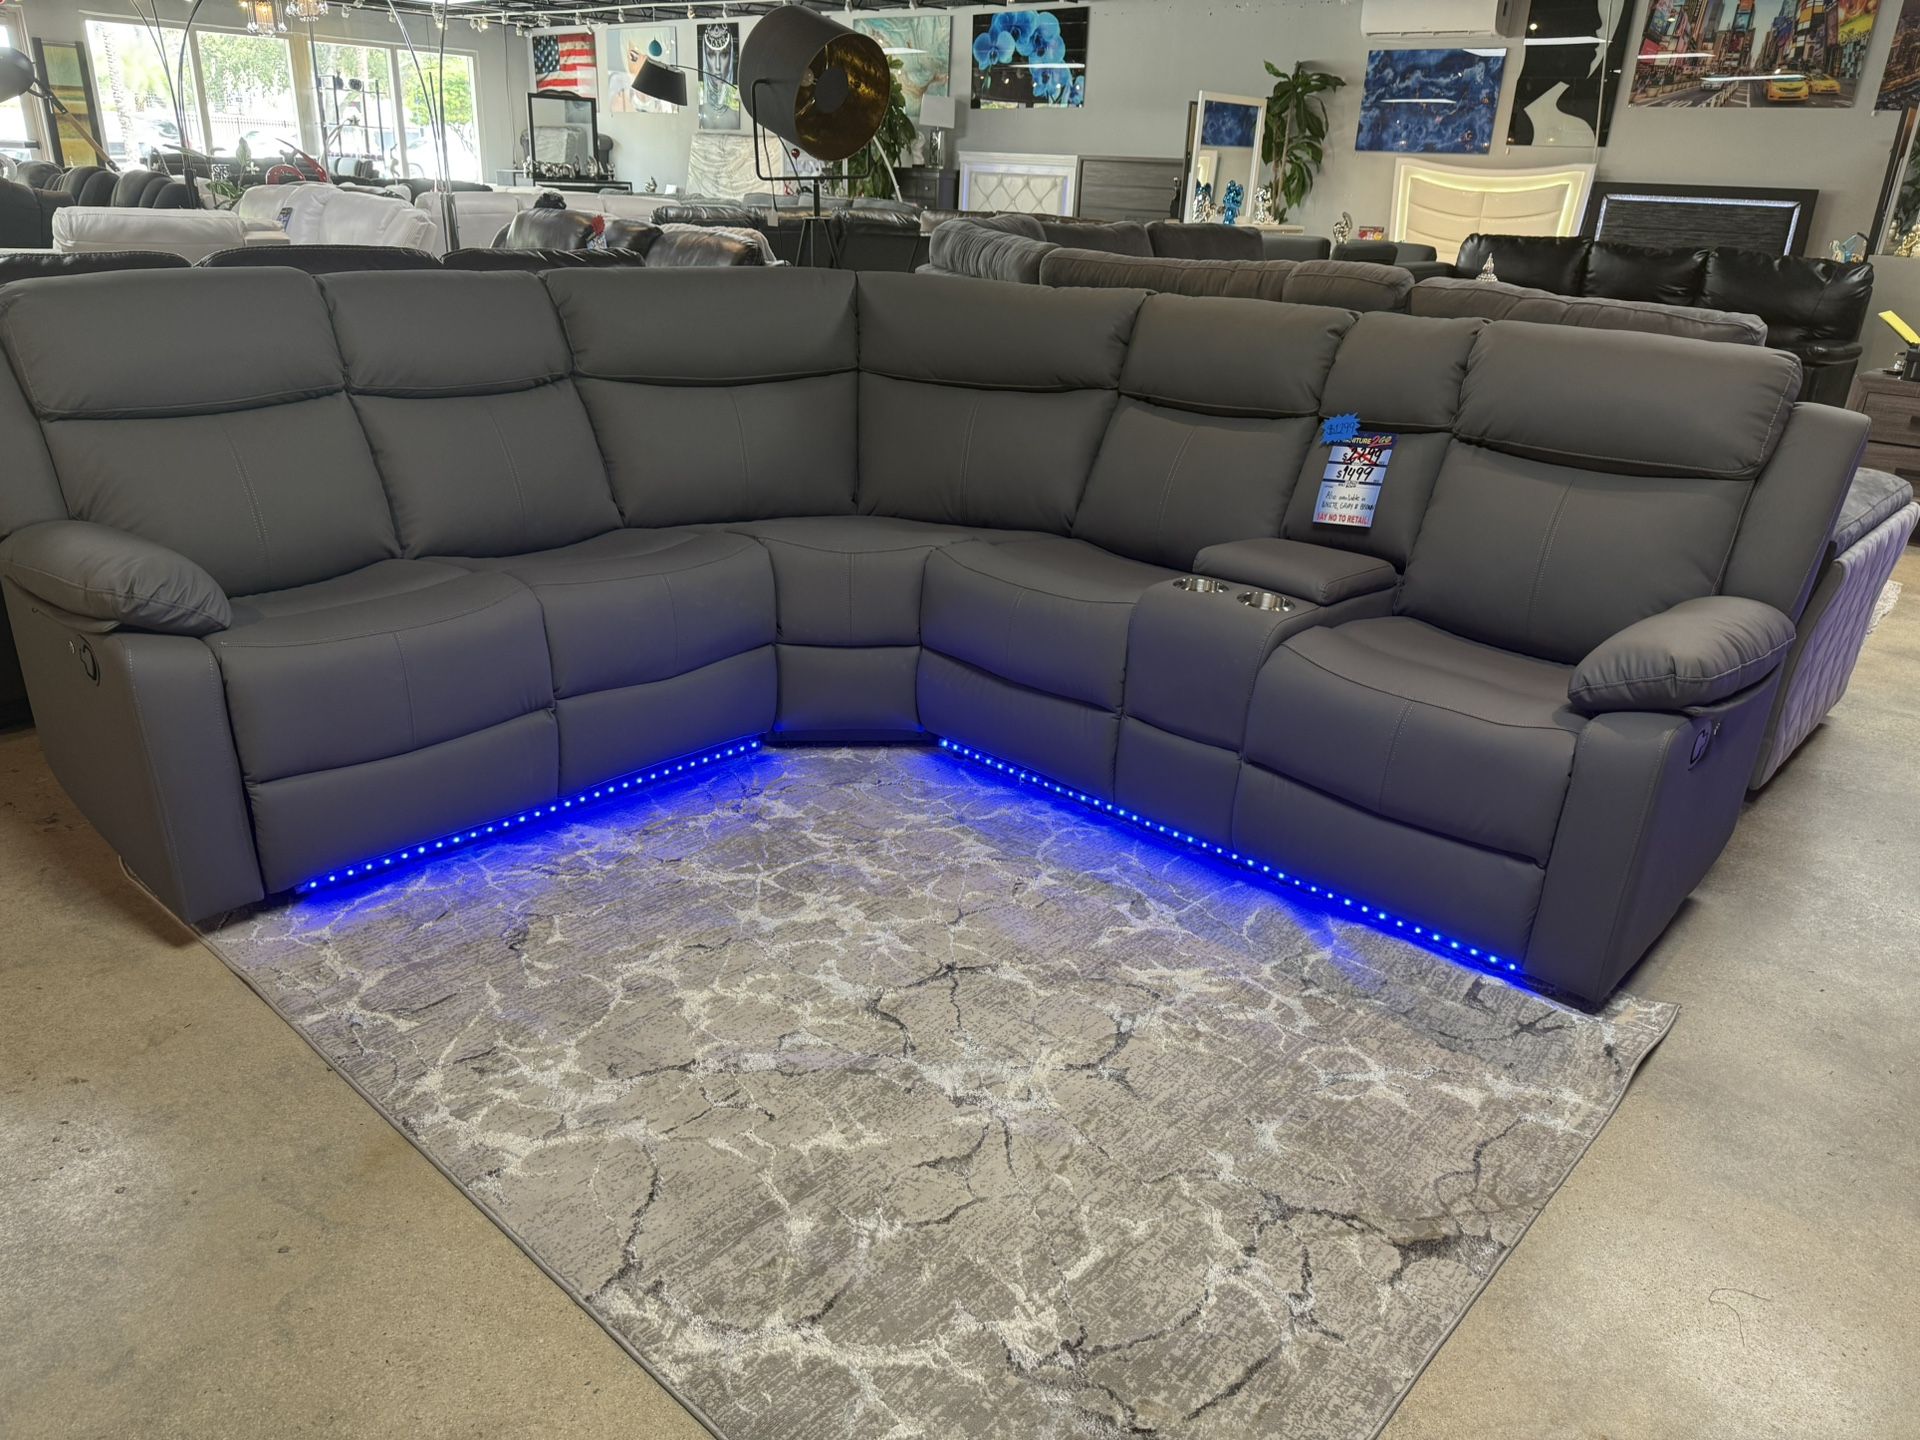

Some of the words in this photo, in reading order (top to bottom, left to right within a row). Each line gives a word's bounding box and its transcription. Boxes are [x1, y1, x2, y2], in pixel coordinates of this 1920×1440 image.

[1336, 465, 1374, 481] $1499
[1329, 513, 1337, 521] NO
[1339, 514, 1346, 522] TO
